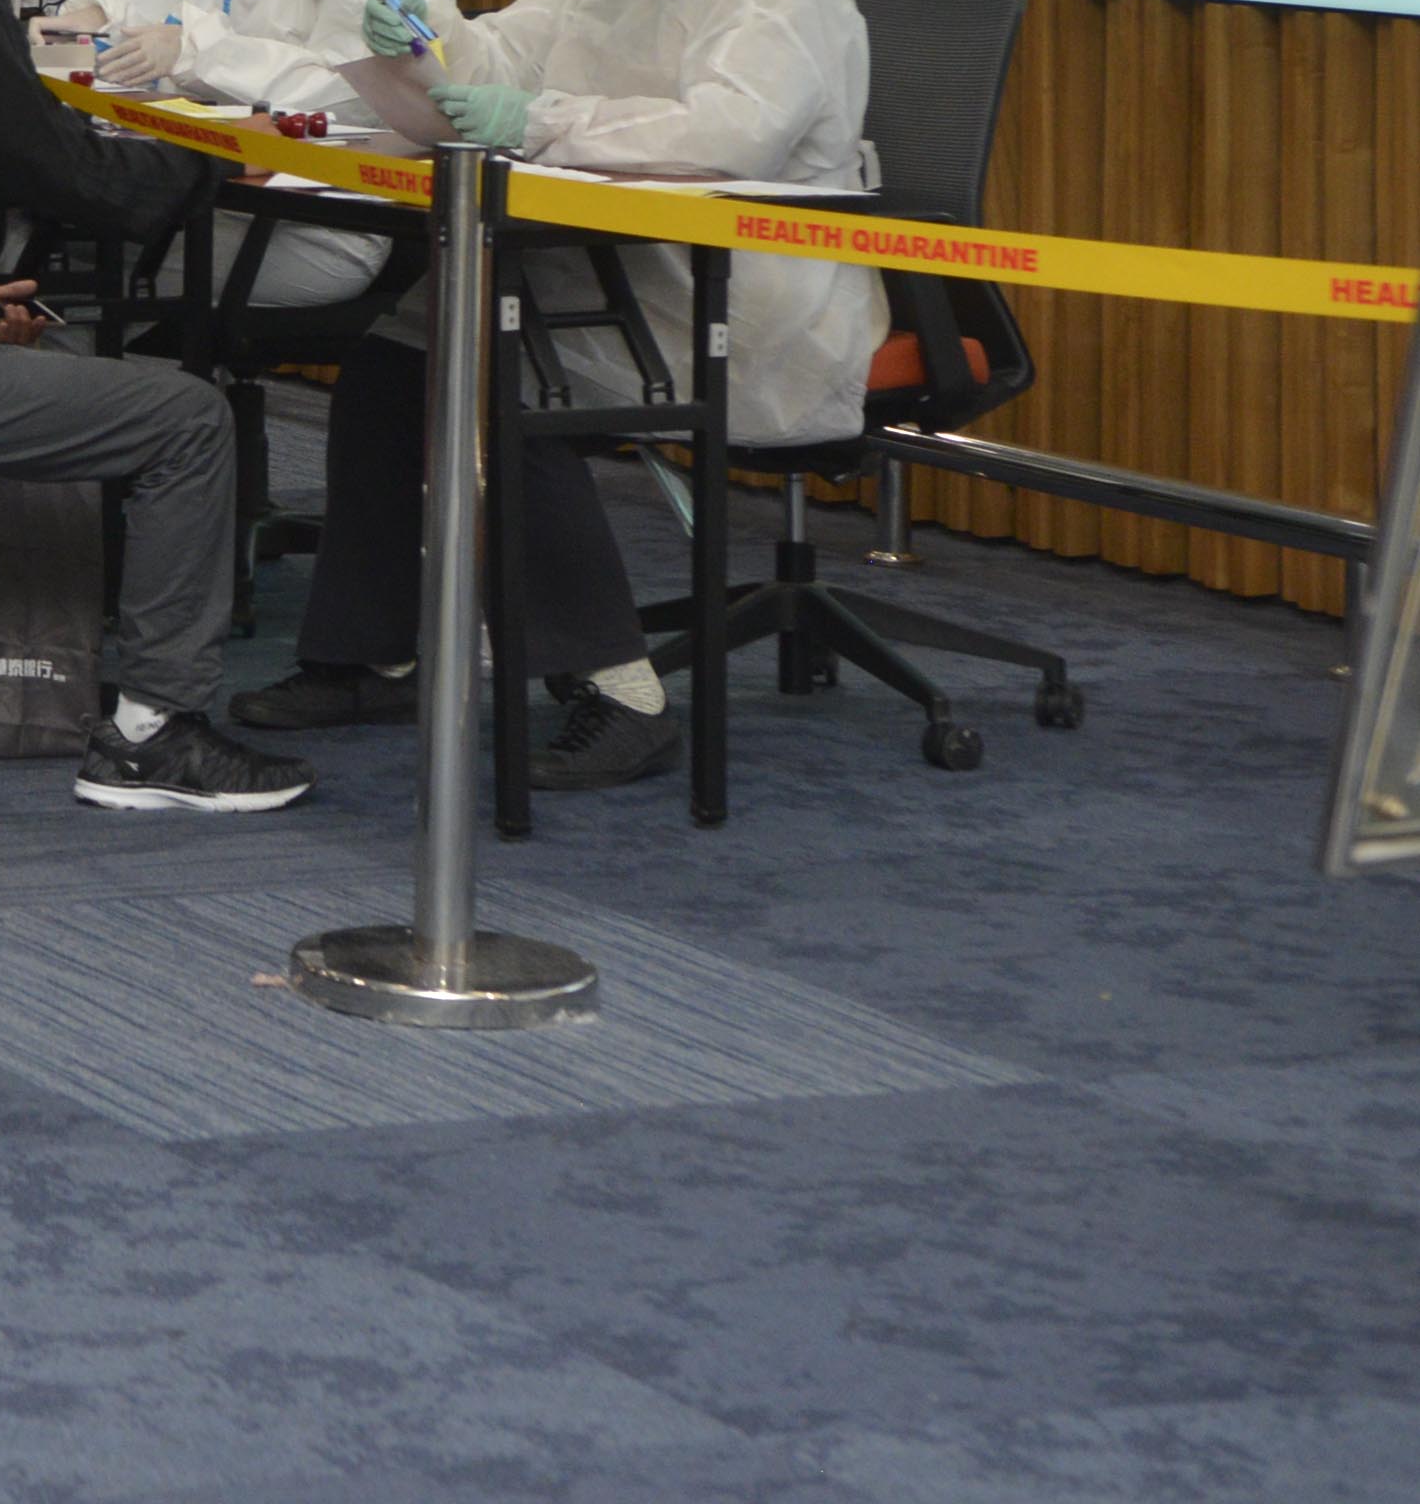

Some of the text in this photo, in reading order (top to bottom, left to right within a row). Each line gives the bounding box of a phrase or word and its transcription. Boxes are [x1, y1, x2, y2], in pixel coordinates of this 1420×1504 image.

[359, 163, 417, 191] HEALTH
[736, 213, 1039, 273] HEALTH QUARANTINE
[1329, 277, 1418, 309] HEAL
